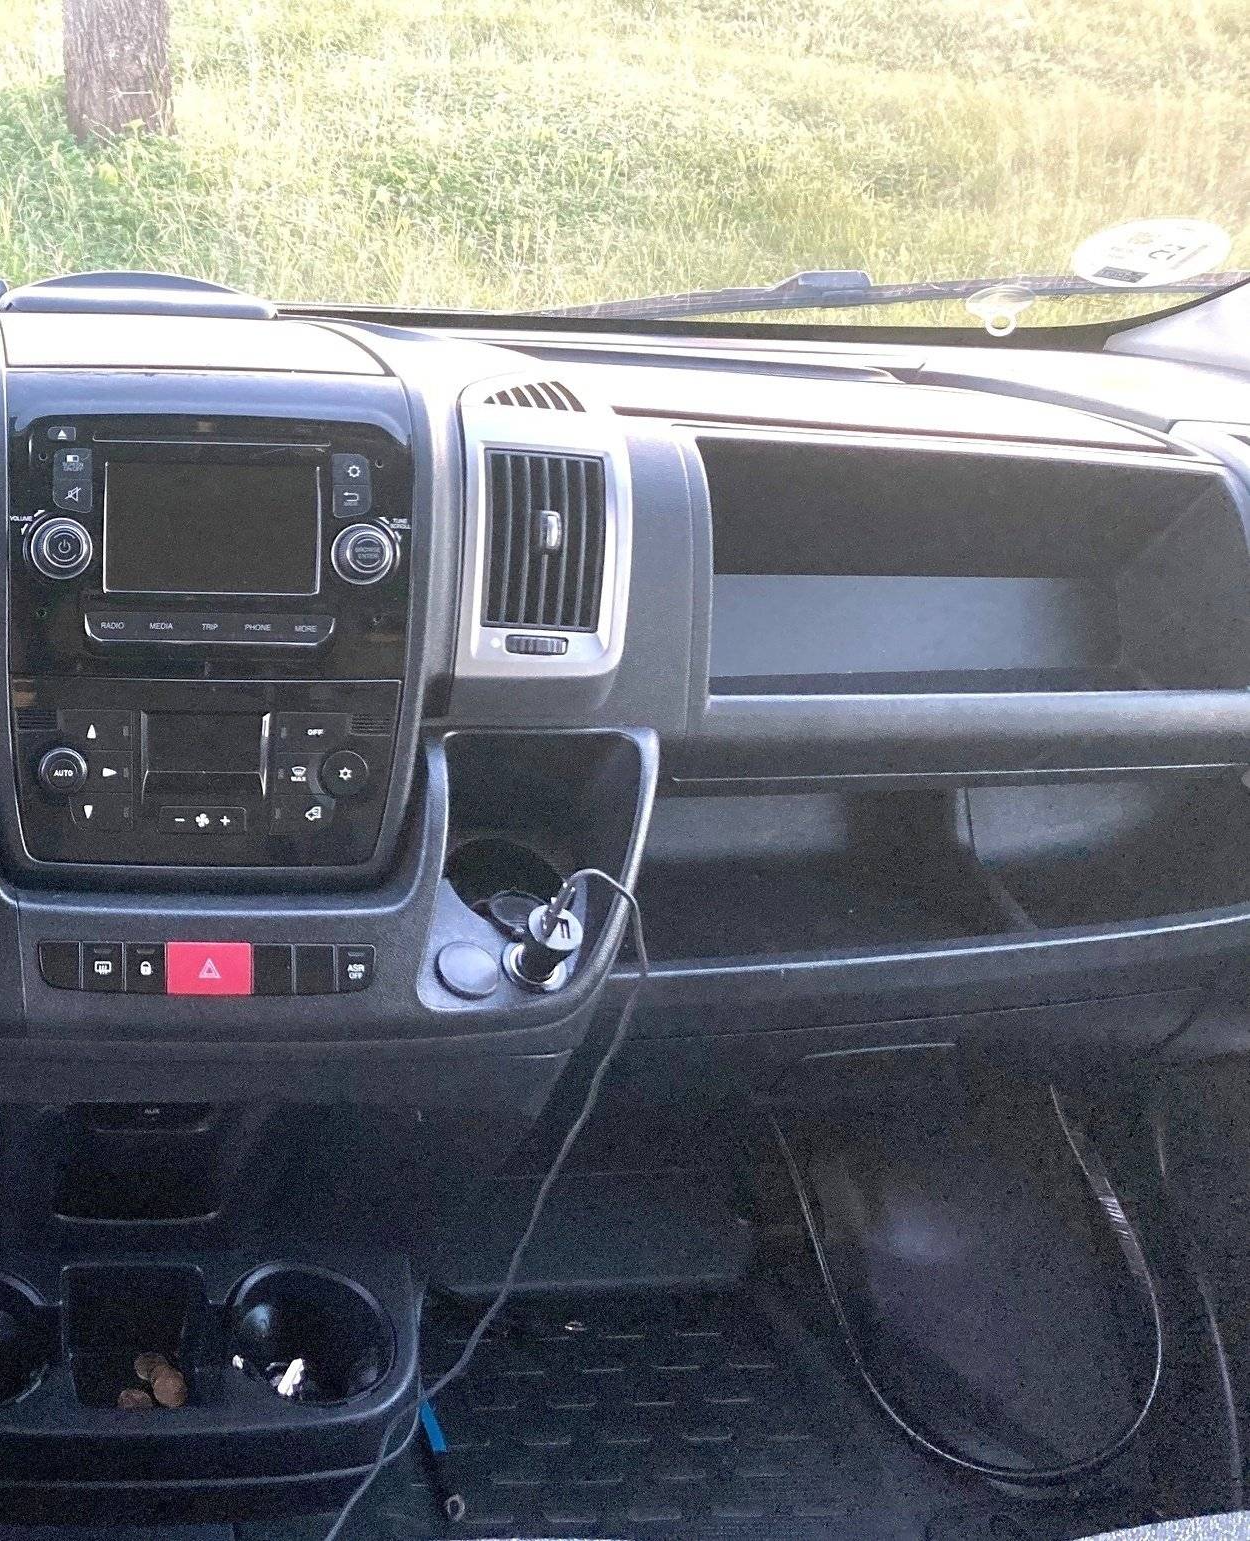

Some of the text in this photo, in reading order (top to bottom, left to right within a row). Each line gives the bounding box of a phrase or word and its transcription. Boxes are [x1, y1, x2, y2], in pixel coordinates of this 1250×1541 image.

[149, 622, 174, 630] MEDIA
[201, 623, 219, 631] TRIP
[244, 623, 272, 631] PHONE
[294, 624, 318, 632] MORE
[307, 728, 324, 736] OFF
[53, 769, 74, 777] AUTO
[347, 964, 365, 972] ASR
